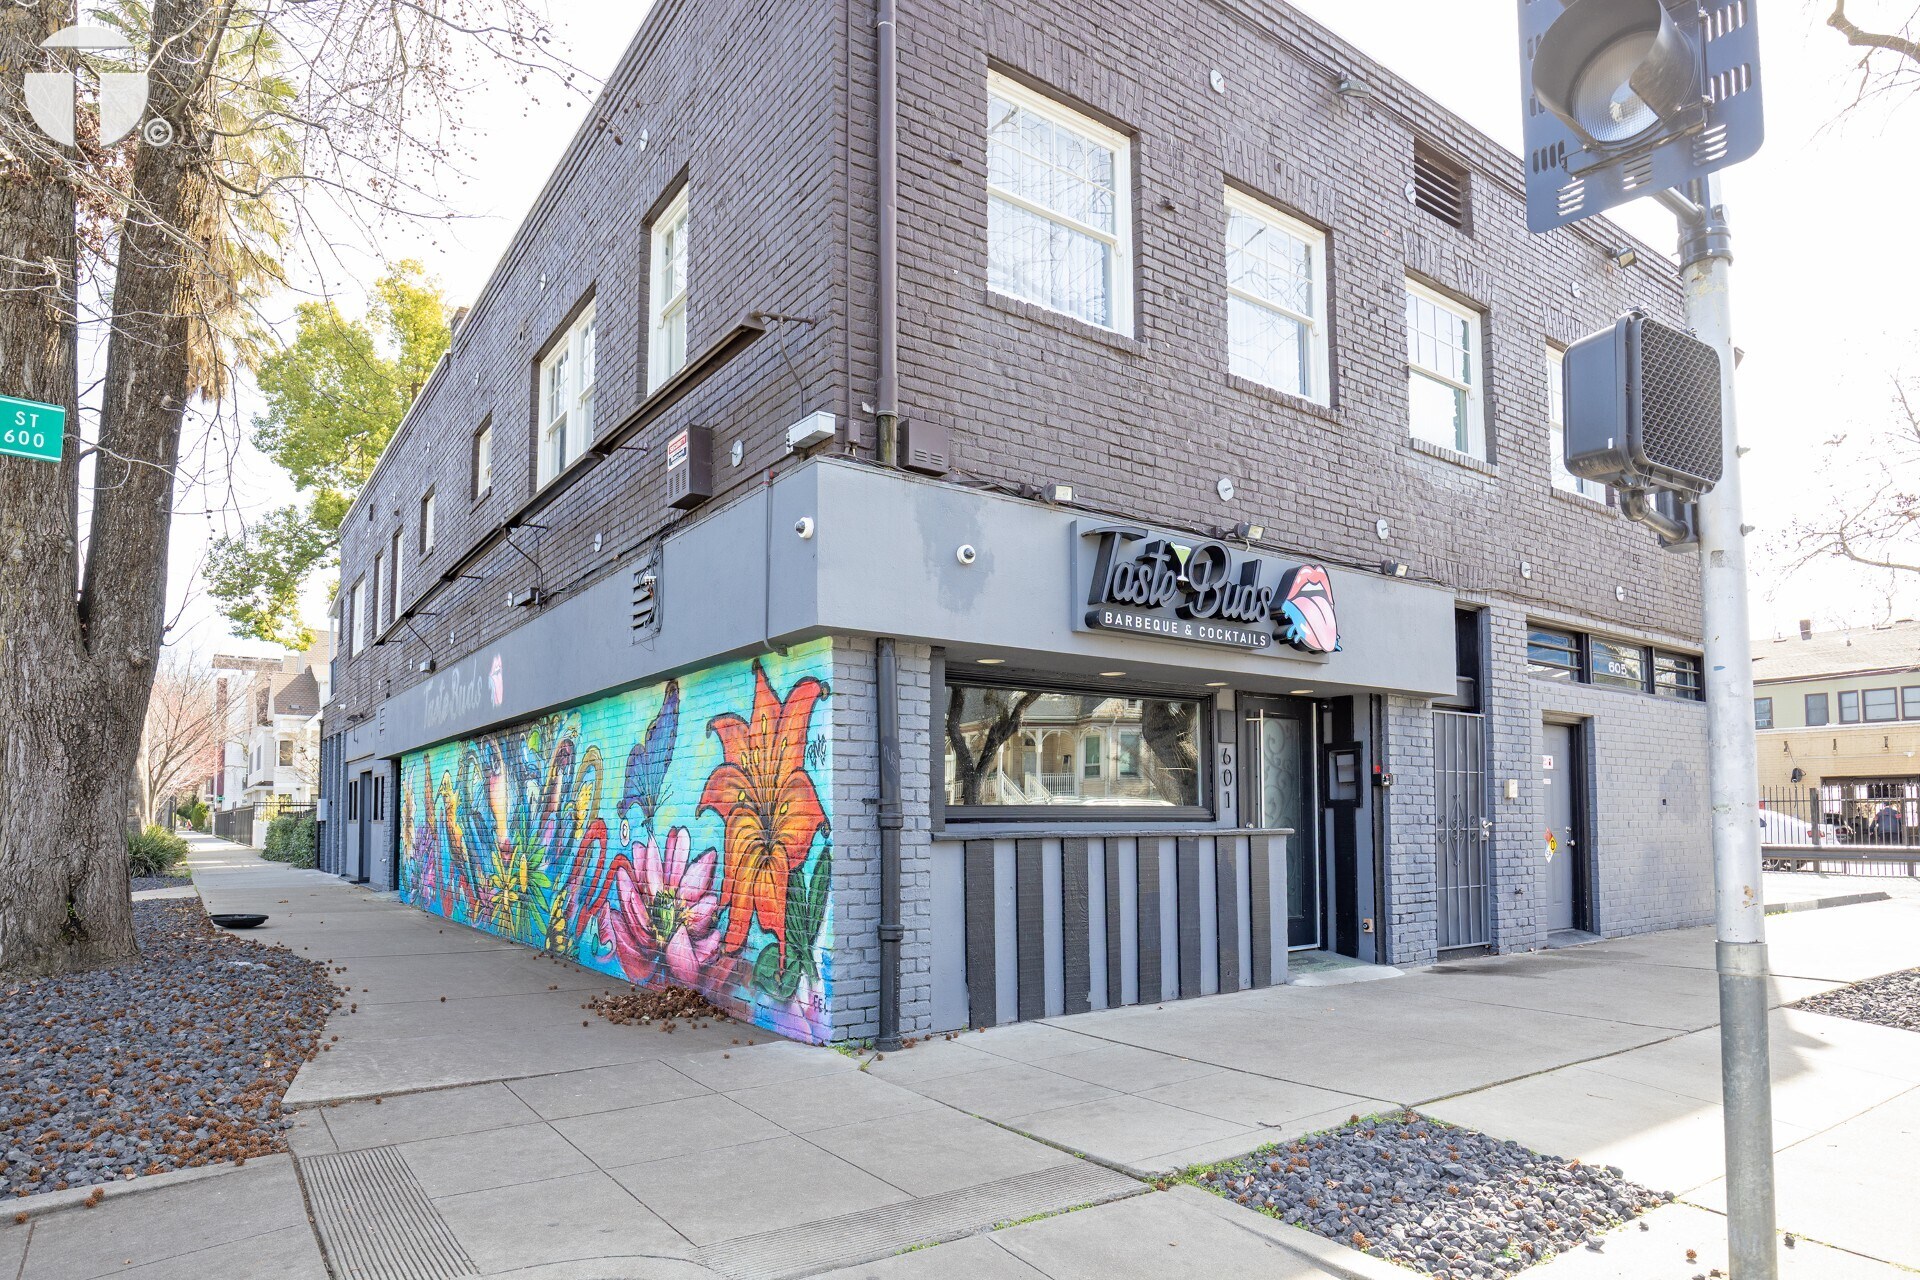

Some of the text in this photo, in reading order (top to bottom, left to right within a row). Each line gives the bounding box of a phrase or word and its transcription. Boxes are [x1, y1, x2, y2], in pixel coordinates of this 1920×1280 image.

[15, 411, 39, 428] ST
[4, 429, 45, 448] 600
[1081, 526, 1272, 623] Taste Buds
[1105, 611, 1267, 646] BARBEQUE & COCKTAILS
[1608, 661, 1627, 676] 605
[1222, 747, 1232, 809] 601
